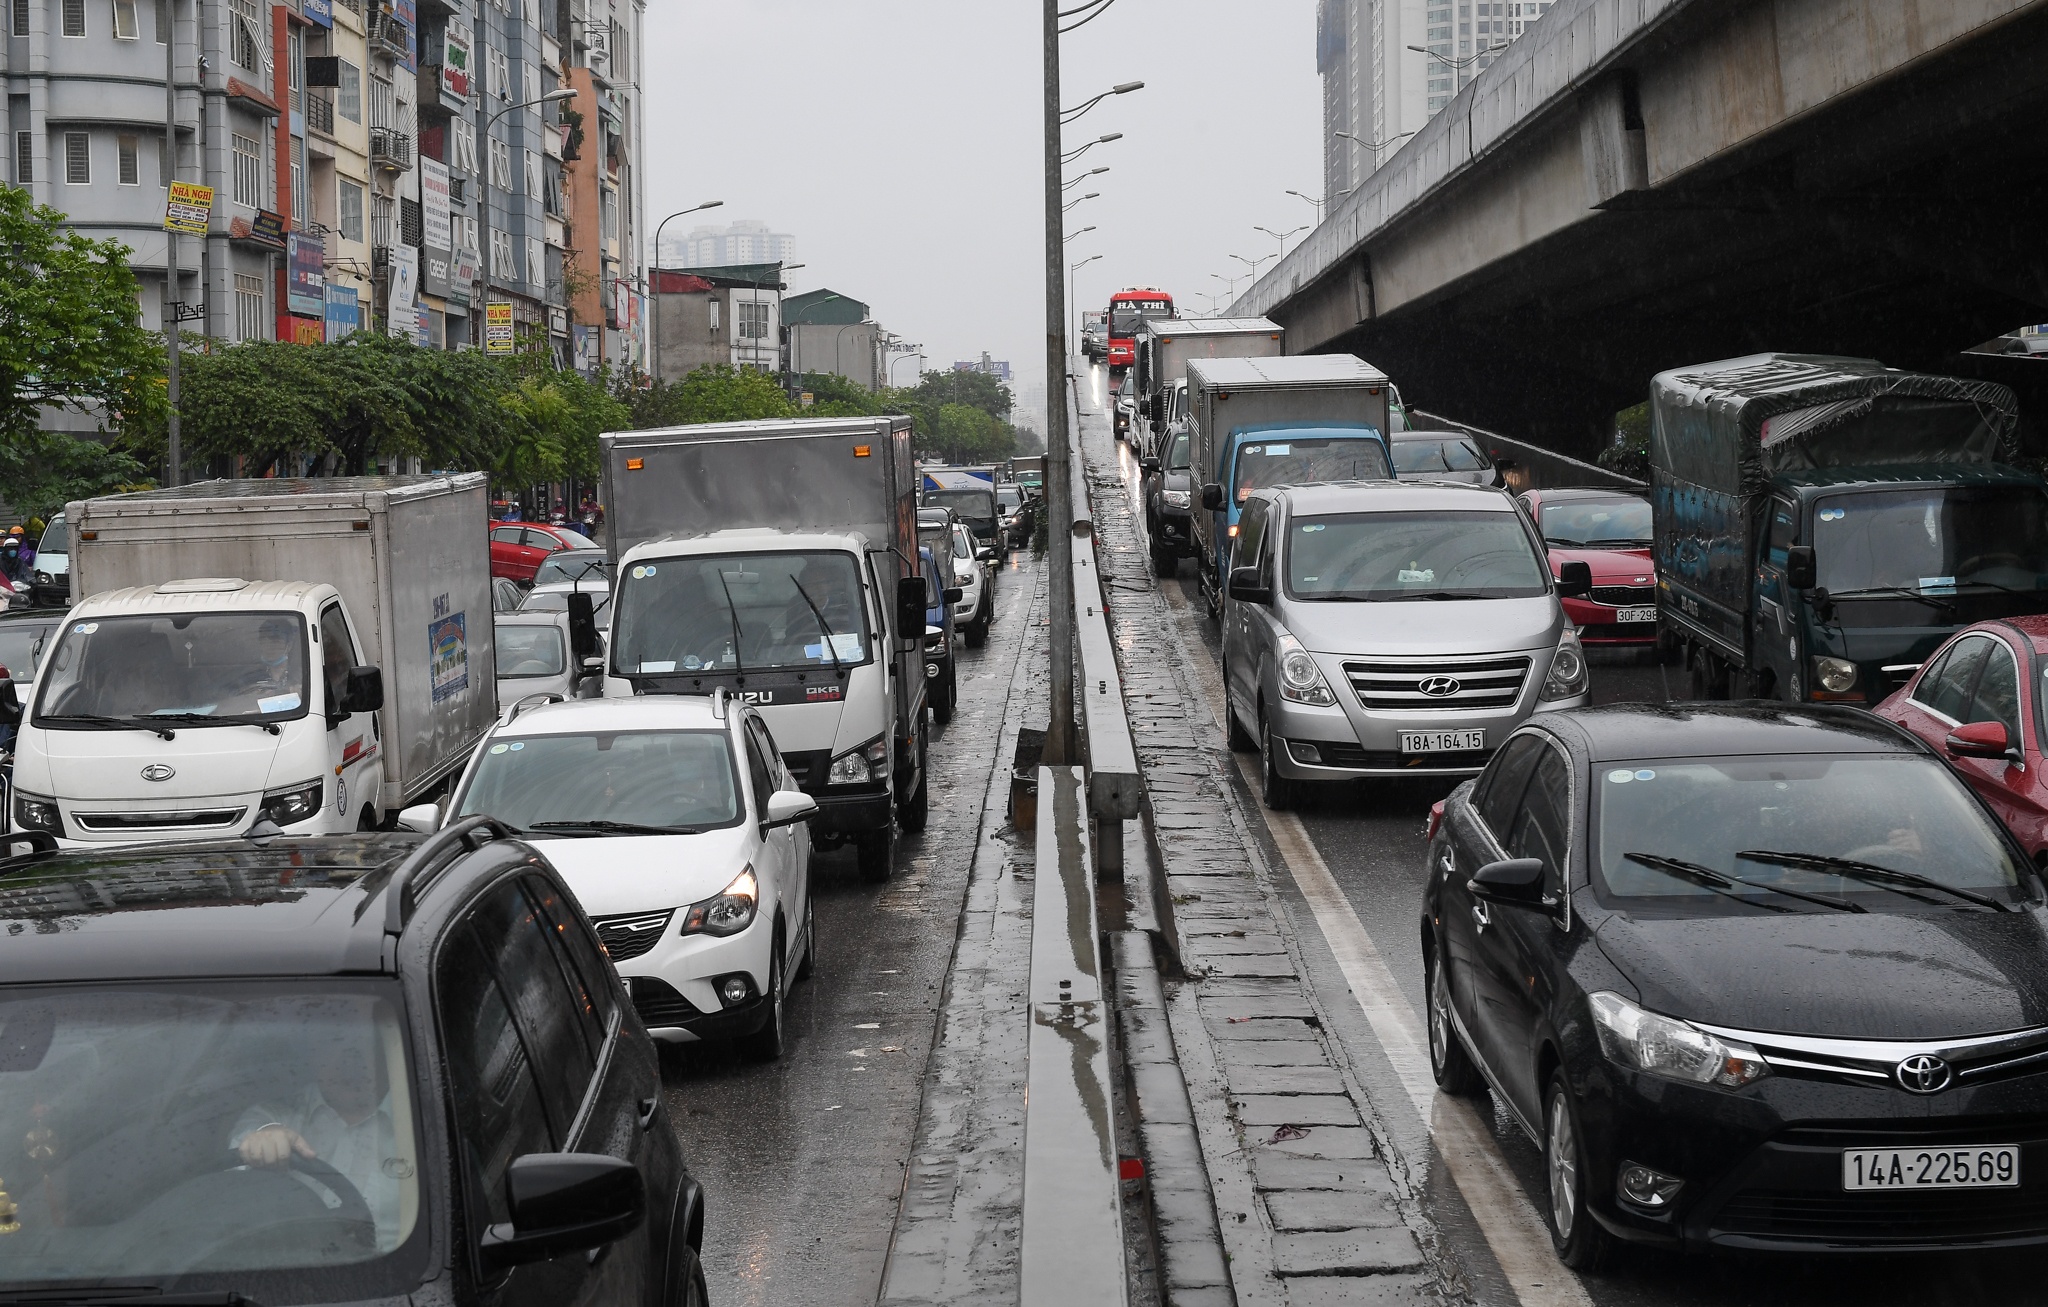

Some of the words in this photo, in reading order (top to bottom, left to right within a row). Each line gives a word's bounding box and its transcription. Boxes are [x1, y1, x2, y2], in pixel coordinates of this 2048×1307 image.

[172, 186, 189, 197] NHÀ
[191, 188, 212, 200] NGHỈ
[1117, 301, 1136, 309] HÀ
[1142, 301, 1165, 309] THÌ
[1406, 733, 1481, 751] 18A-164.15
[1853, 1151, 2013, 1186] 14A-225.69
